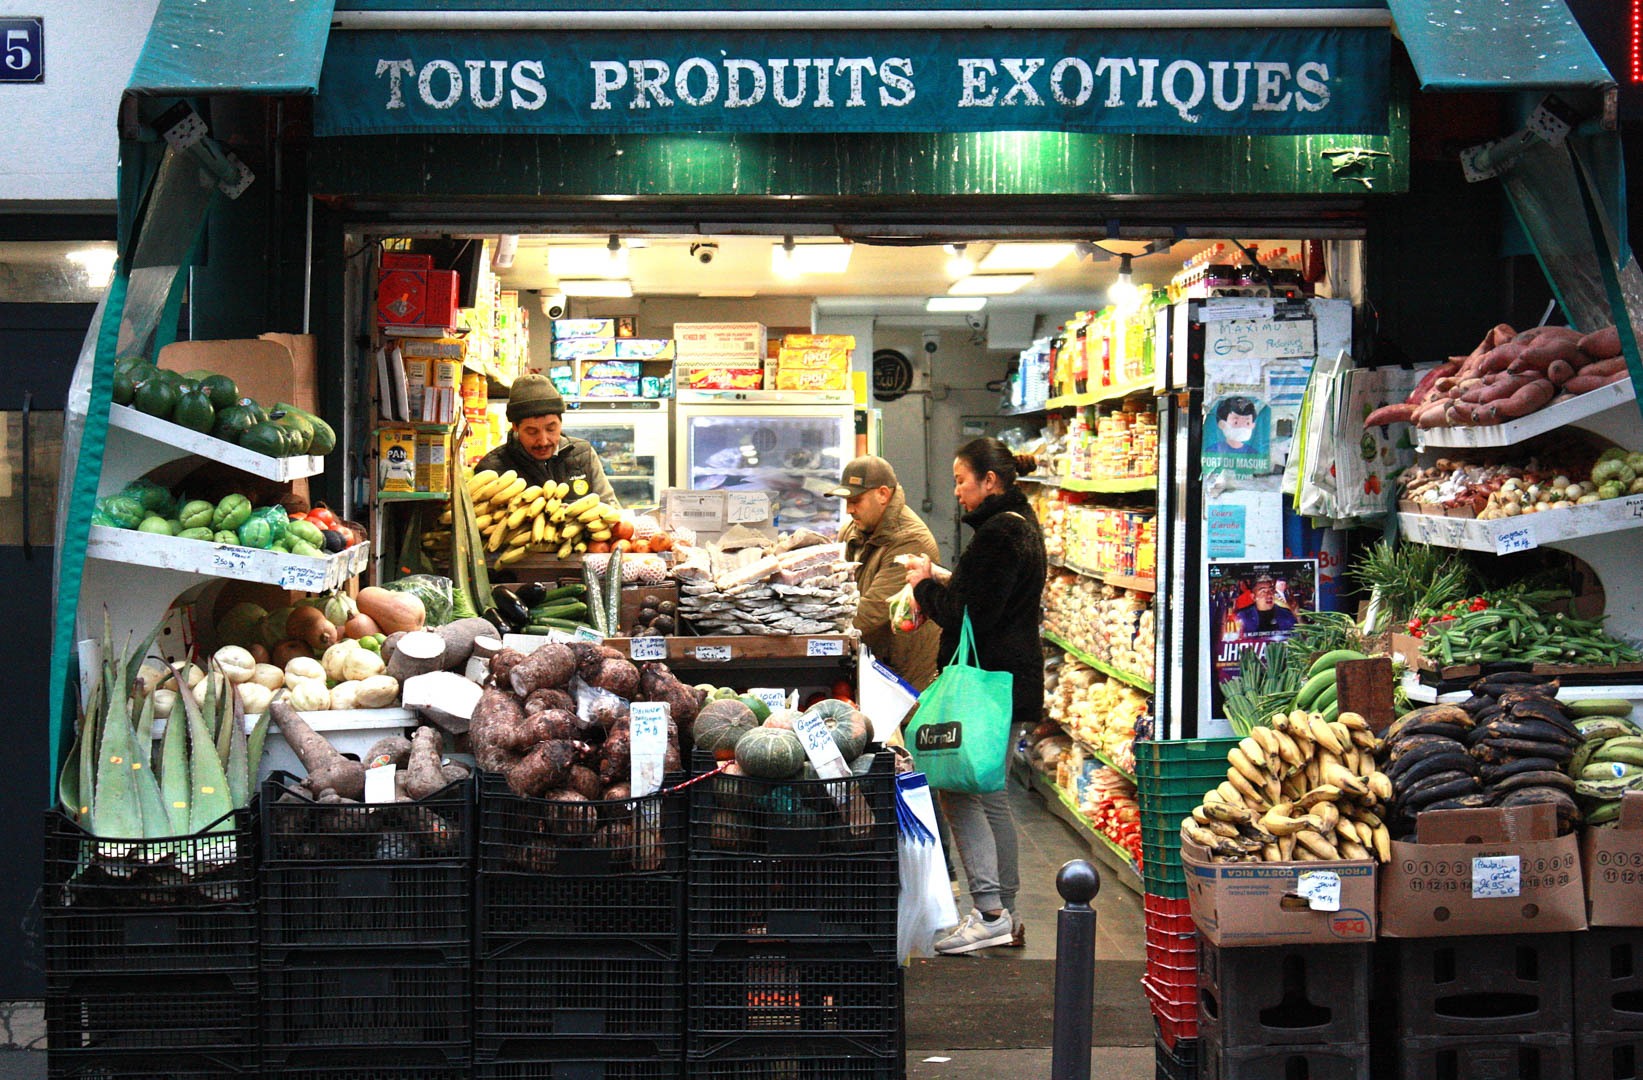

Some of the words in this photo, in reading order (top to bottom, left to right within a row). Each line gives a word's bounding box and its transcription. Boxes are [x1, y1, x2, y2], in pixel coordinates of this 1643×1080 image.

[5, 29, 32, 70] 5
[375, 59, 548, 110] TOUS
[589, 57, 916, 110] PRODUITS
[957, 57, 1331, 123] EXOTIQUES
[387, 450, 407, 458] PAN
[1201, 457, 1221, 468] PORT
[1223, 458, 1234, 468] DU
[1236, 458, 1268, 470] MASQUE
[920, 727, 957, 745] Normal
[1227, 870, 1253, 878] RICA
[1257, 869, 1294, 878] COSTA
[1332, 919, 1365, 936] Dole
